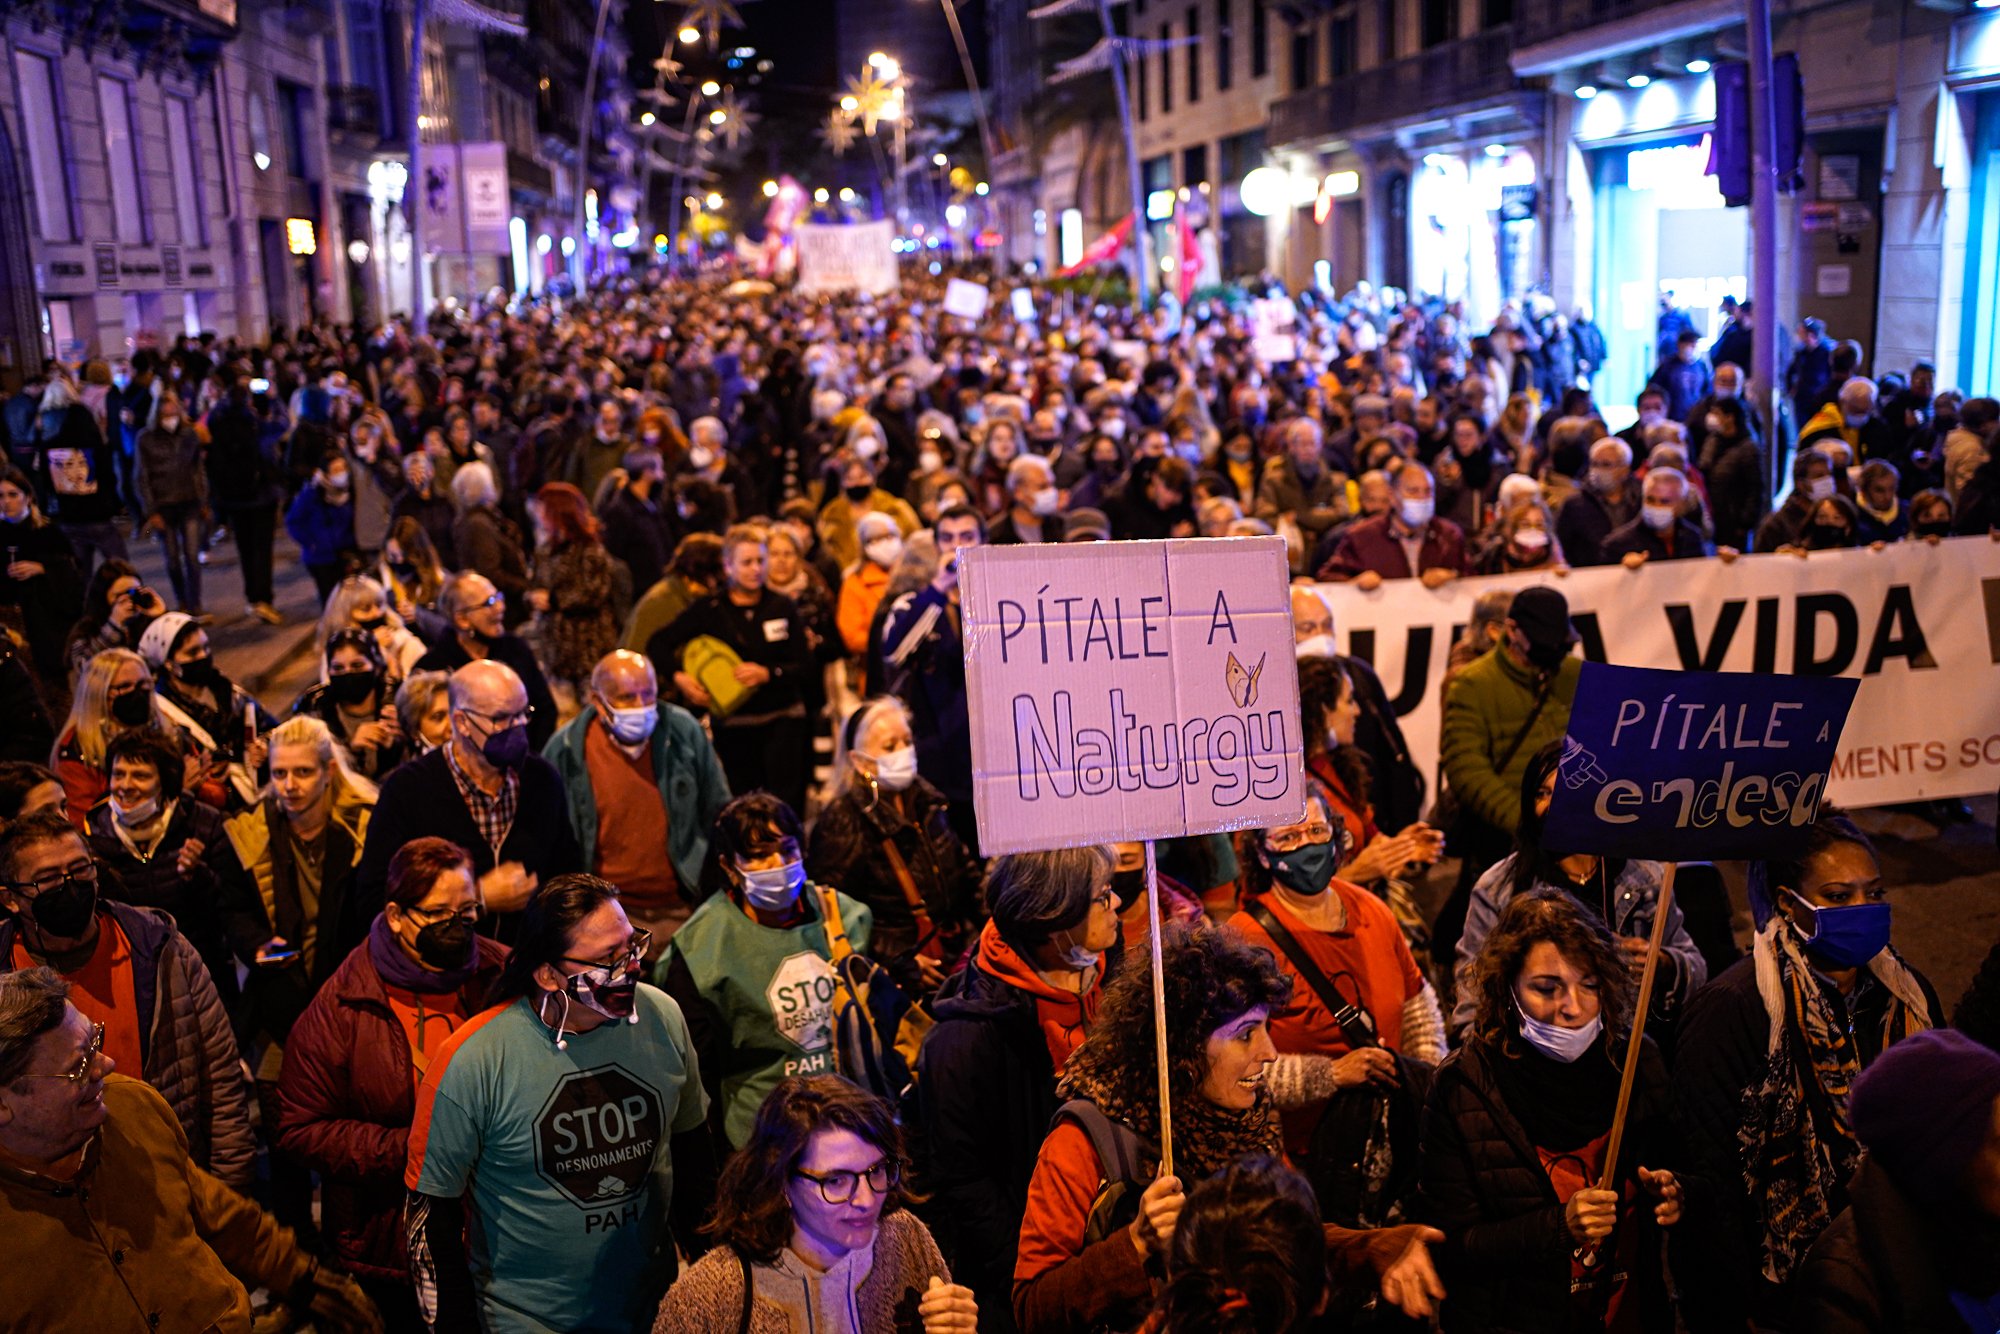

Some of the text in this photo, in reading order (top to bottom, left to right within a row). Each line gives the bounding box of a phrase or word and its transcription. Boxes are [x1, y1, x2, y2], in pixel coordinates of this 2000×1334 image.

[998, 584, 1238, 664] PÍTALE A
[1664, 583, 1938, 676] VIDA
[1012, 688, 1290, 807] Naturgy
[1611, 693, 1830, 750] PÍTALE A
[1594, 761, 1827, 829] endesa
[777, 975, 837, 1014] STO
[785, 1054, 825, 1077] PAH
[552, 1094, 648, 1155] STOP
[556, 1139, 654, 1175] DESNONAMENTS
[585, 1203, 639, 1235] PAH
